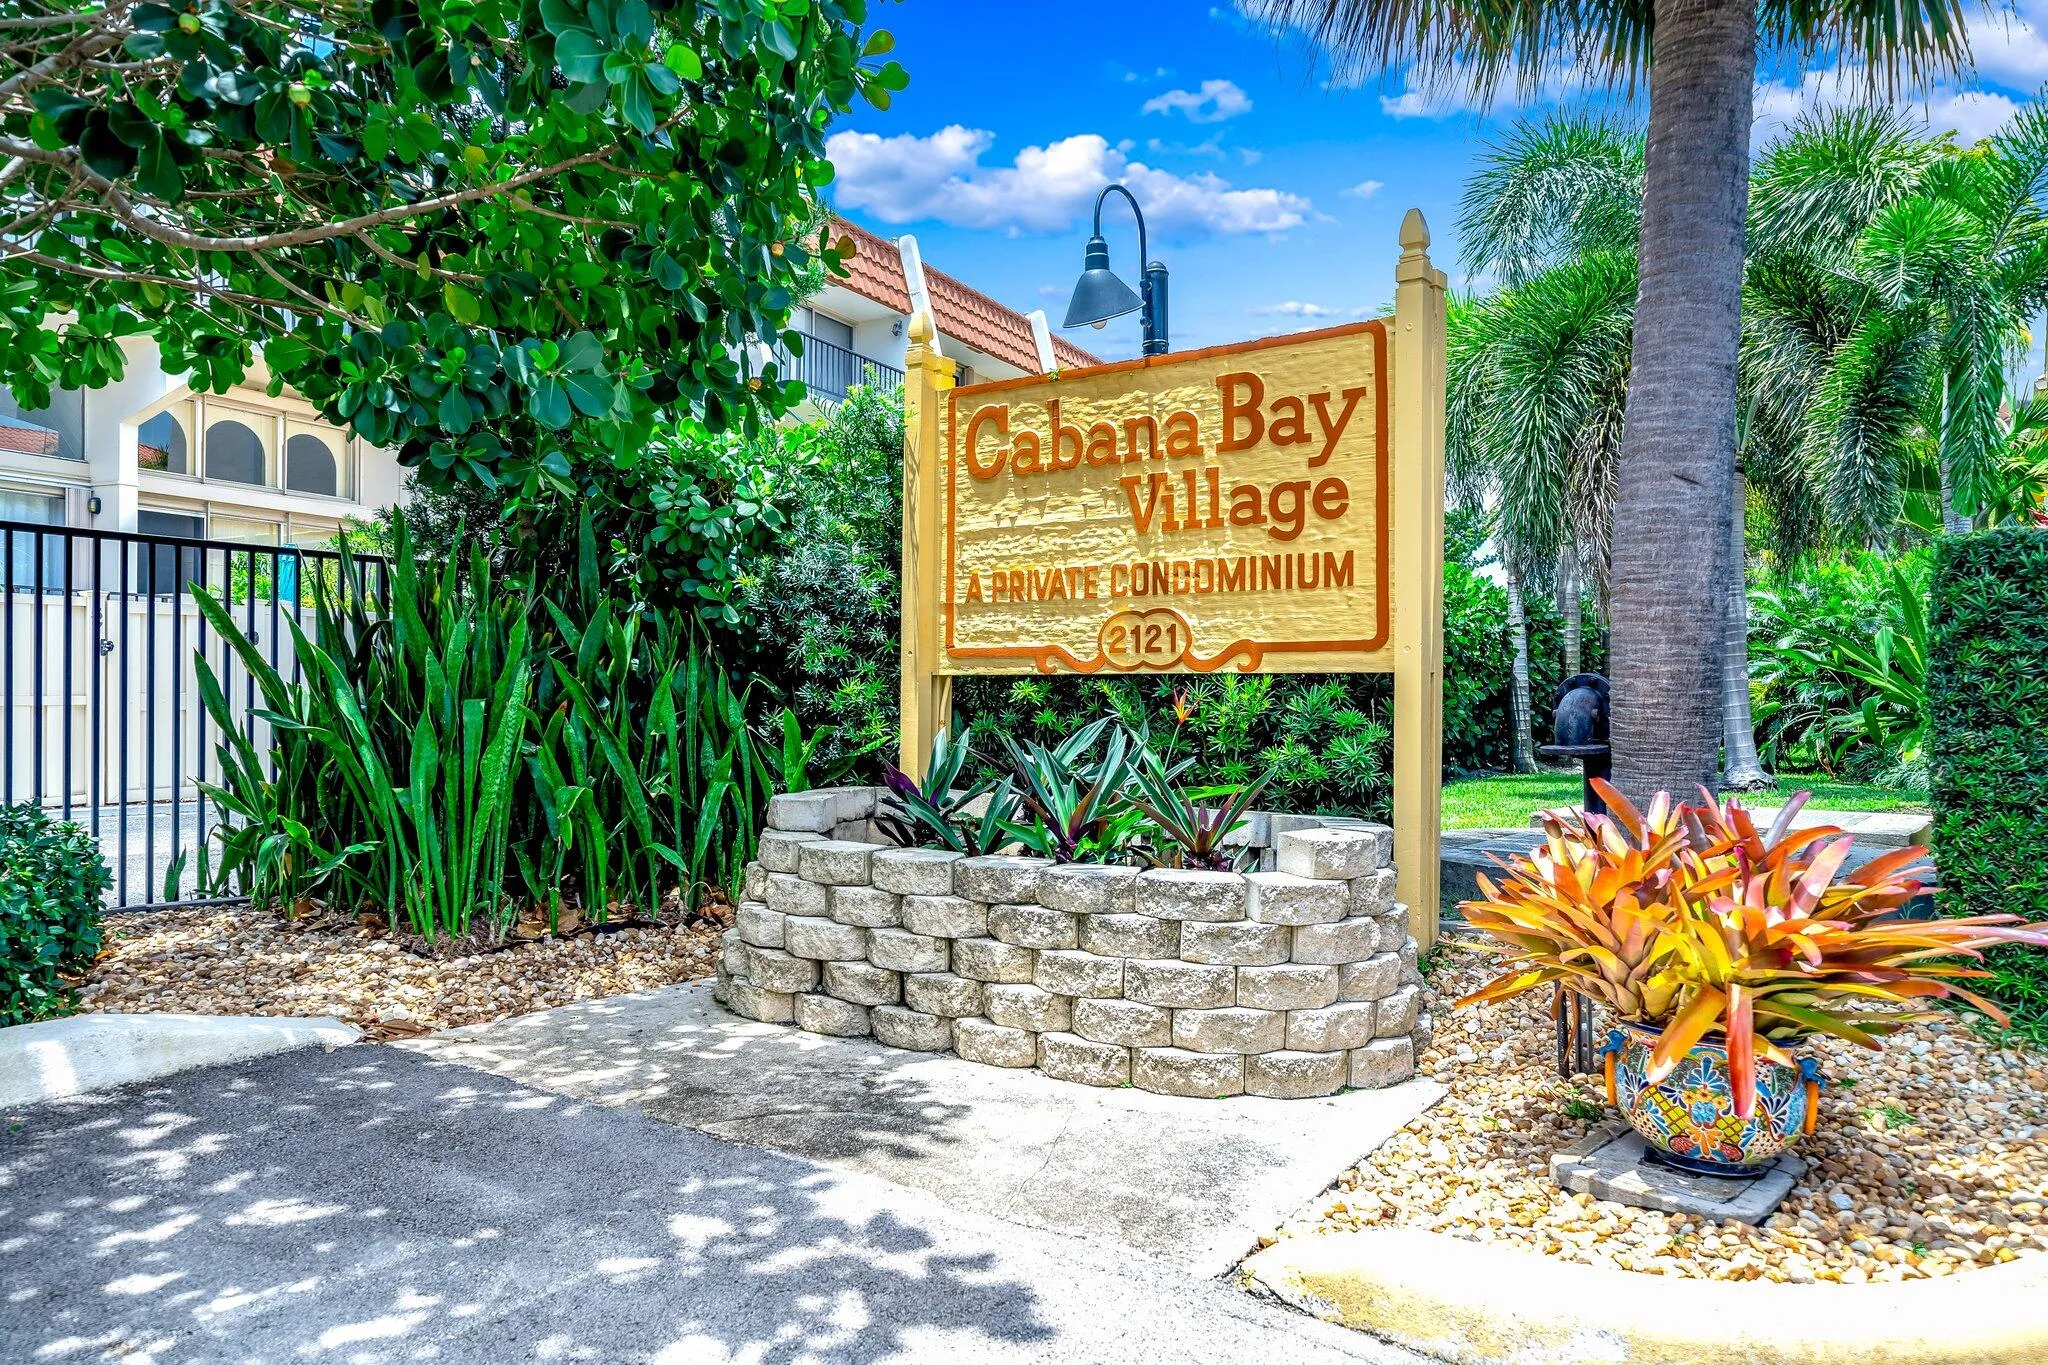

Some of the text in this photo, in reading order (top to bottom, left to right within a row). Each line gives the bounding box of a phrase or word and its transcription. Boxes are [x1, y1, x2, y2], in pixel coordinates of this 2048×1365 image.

[965, 371, 1367, 480] Cabana Bay
[1119, 467, 1350, 541] Village
[966, 550, 1355, 603] A PRIVATE CONDOMINIUM
[1108, 622, 1178, 655] 2121
